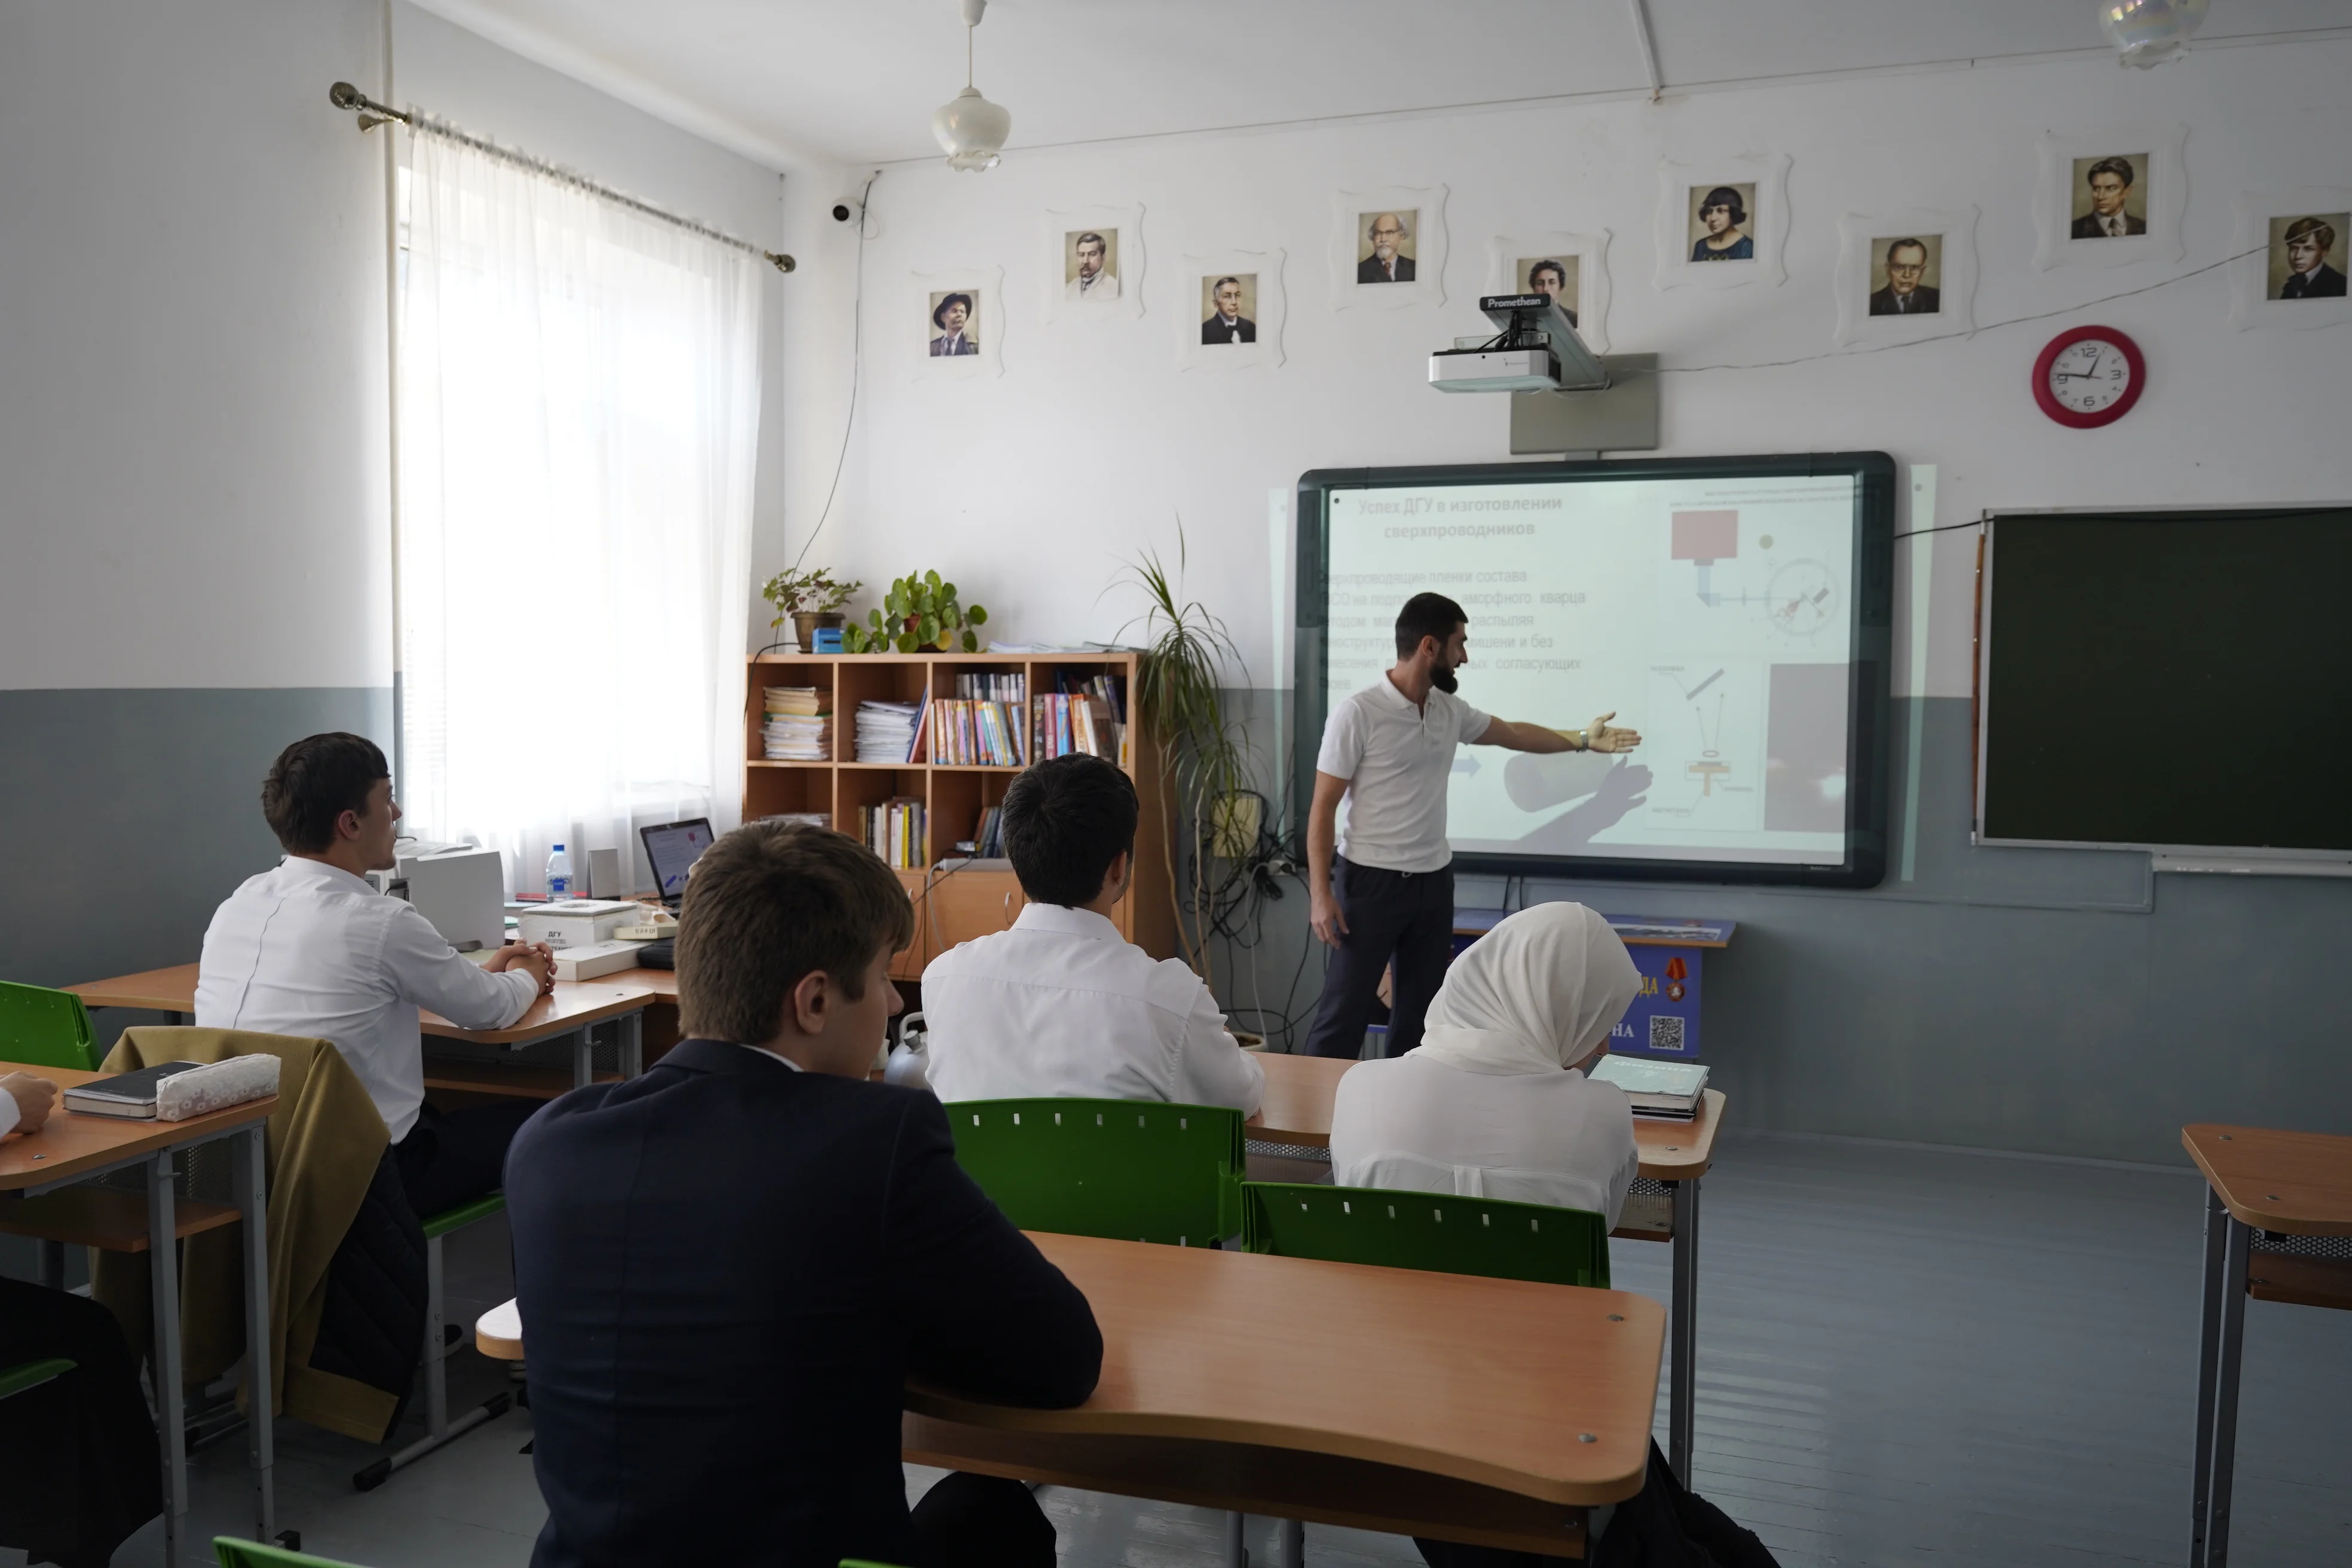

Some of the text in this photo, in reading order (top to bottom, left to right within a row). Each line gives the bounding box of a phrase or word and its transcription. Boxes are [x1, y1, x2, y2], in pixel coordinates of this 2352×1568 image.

[1488, 296, 1541, 308] Promethean
[2081, 347, 2097, 358] 12
[2057, 373, 2068, 385] 9
[2111, 369, 2122, 381] 3
[2083, 396, 2095, 407] 6
[1358, 497, 1563, 517] Успех ДГУ в изготовлении
[1384, 522, 1536, 541] сверхпроводников
[1429, 572, 1473, 584] пленки
[1476, 570, 1527, 584] состава
[1461, 590, 1532, 608] аморфного
[1539, 590, 1586, 607] кварца
[1520, 636, 1528, 648] и
[1530, 633, 1554, 648] без
[1495, 658, 1582, 674] согласующих
